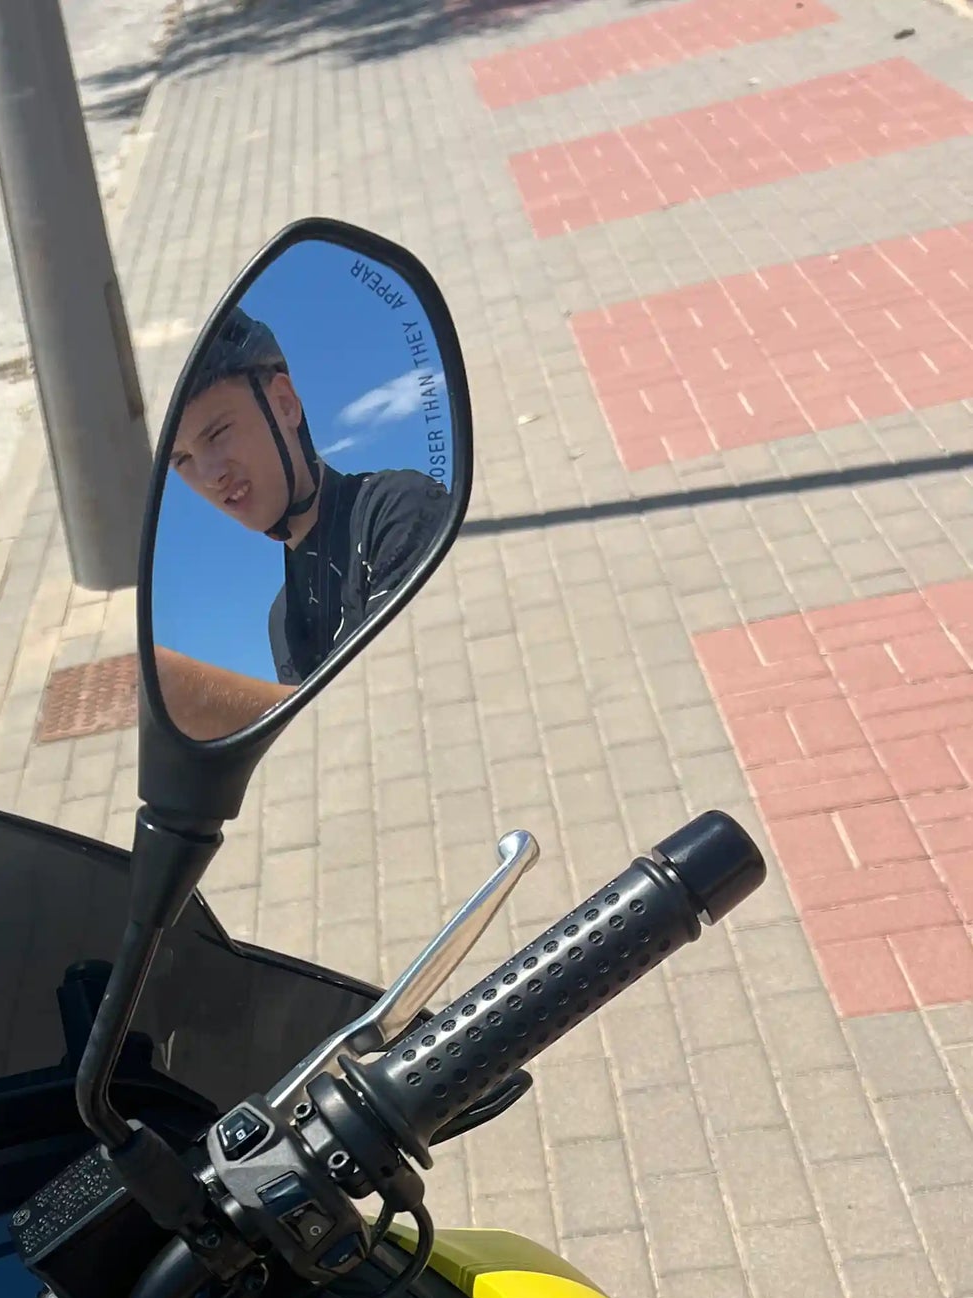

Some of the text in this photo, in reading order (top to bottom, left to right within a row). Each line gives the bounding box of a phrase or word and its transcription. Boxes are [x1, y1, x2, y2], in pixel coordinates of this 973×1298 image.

[350, 259, 407, 310] APPEAR
[402, 320, 430, 369] THEY
[418, 374, 441, 424] THAN
